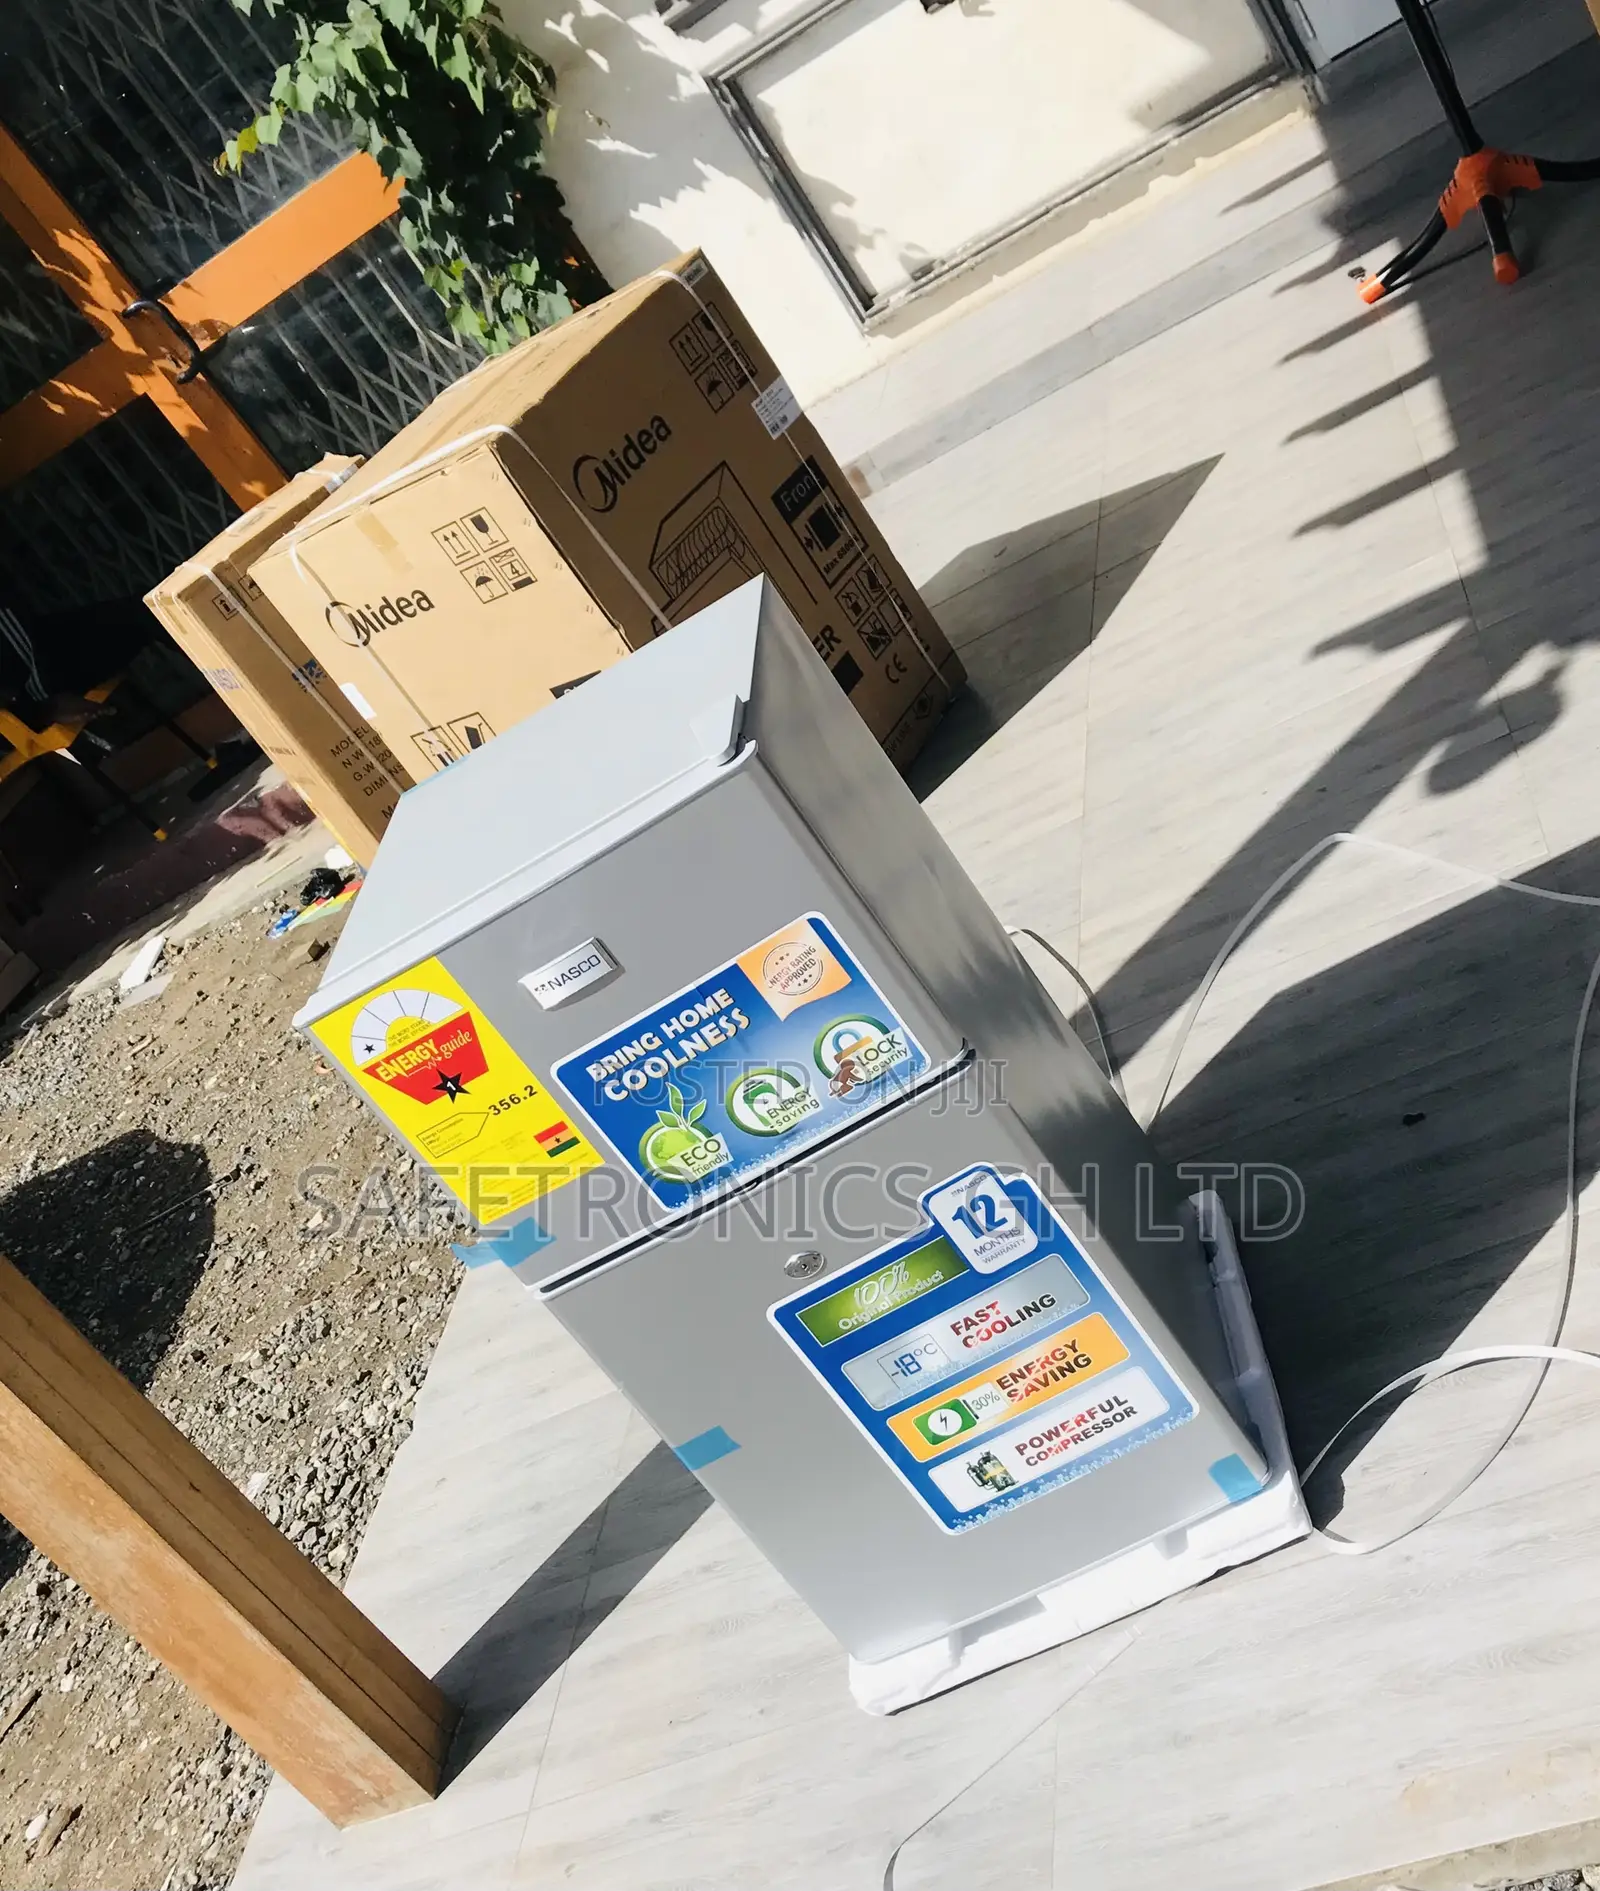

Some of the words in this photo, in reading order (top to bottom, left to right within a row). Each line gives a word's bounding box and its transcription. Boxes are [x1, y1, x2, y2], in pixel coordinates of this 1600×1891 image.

[573, 414, 672, 513] Midea
[325, 589, 435, 648] Midea
[547, 954, 601, 990] NASCO
[780, 958, 817, 992] APPROVED
[790, 945, 817, 969] RATING
[585, 1032, 664, 1082] BRING
[659, 987, 735, 1040] HOME
[856, 1034, 902, 1067] LOCK
[375, 1038, 439, 1082] ENERGY
[439, 1029, 473, 1059] guide
[604, 1007, 750, 1101] COOLNESS
[867, 1047, 908, 1076] security
[446, 1081, 456, 1091] 1
[488, 1084, 538, 1116] 356.2
[766, 1088, 812, 1119] ENERGY
[776, 1099, 820, 1127] saving
[680, 1139, 721, 1167] ECO
[692, 1152, 730, 1176] friendly
[952, 1194, 1008, 1239] 12
[973, 1226, 1021, 1257] MONTHS
[983, 1238, 1026, 1264] WARRANTY
[838, 1295, 894, 1330] Original
[895, 1270, 944, 1300] Product
[854, 1261, 910, 1308] 100%
[950, 1300, 1000, 1337] FAST
[962, 1293, 1056, 1348] COOLING
[996, 1339, 1079, 1390] ENERGY
[1006, 1353, 1092, 1402] SAVING
[972, 1390, 1001, 1411] 30%
[1015, 1395, 1129, 1456] POWERFUL
[1025, 1406, 1138, 1466] COMPRESSOR
